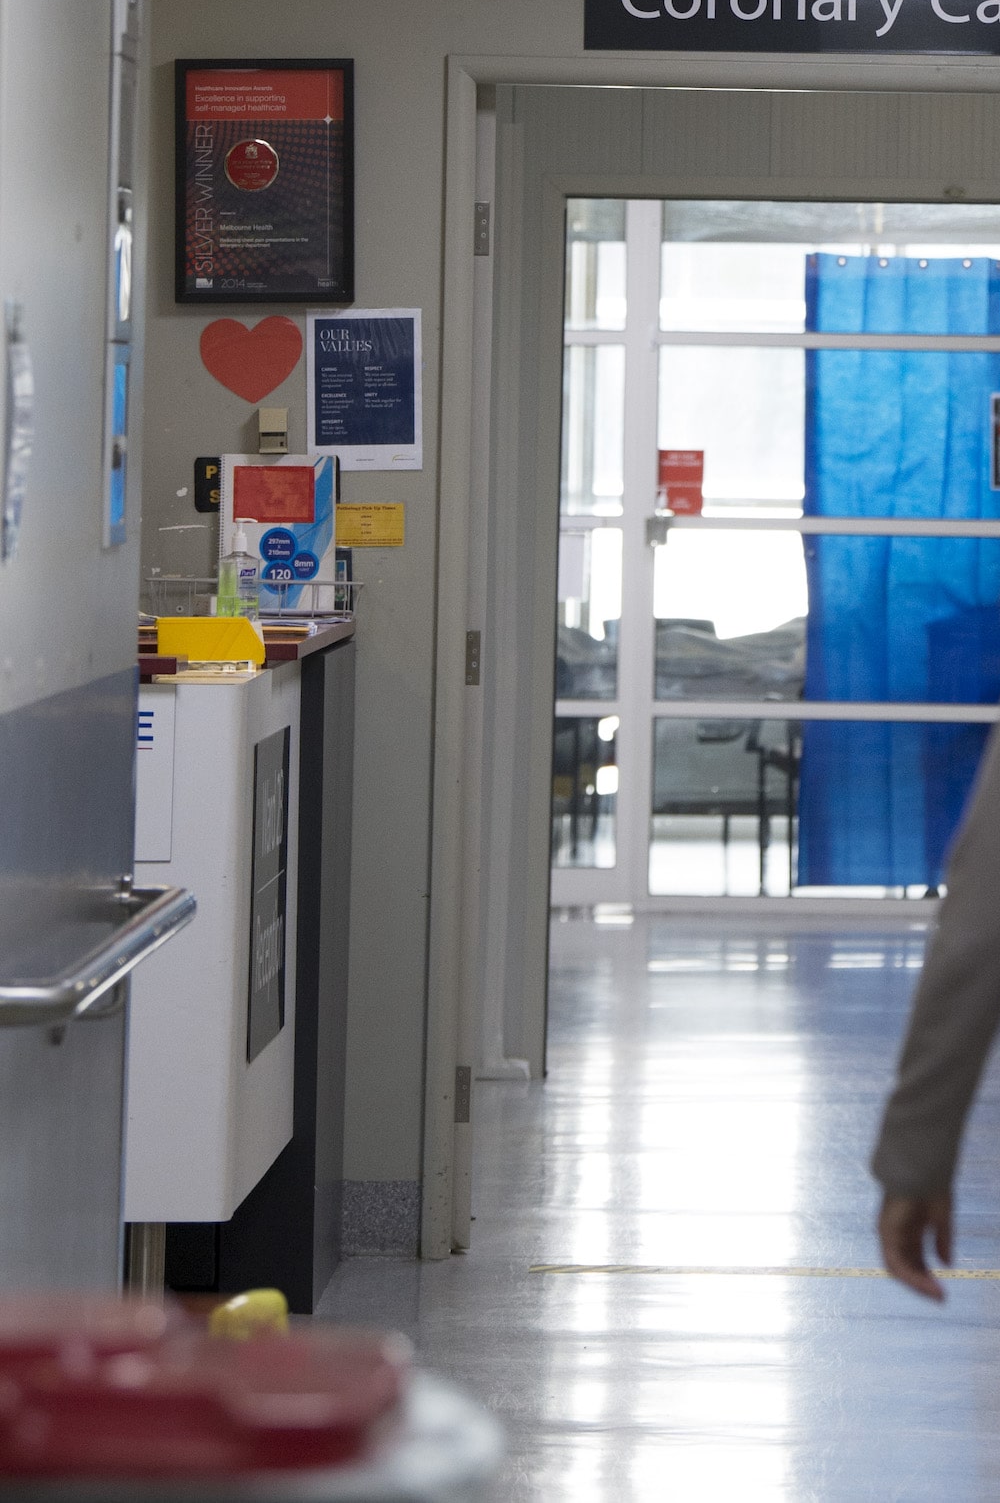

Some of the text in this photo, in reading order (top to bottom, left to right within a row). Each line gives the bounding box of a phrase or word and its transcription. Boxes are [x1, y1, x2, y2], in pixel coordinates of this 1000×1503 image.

[245, 95, 286, 104] supporting
[195, 125, 213, 203] WINNER
[195, 207, 213, 272] SILVER
[221, 279, 245, 288] 2014
[320, 329, 350, 340] OUR
[320, 340, 373, 353] VALUES
[206, 465, 218, 480] P
[270, 569, 291, 580] 120
[255, 910, 283, 1002] Reception
